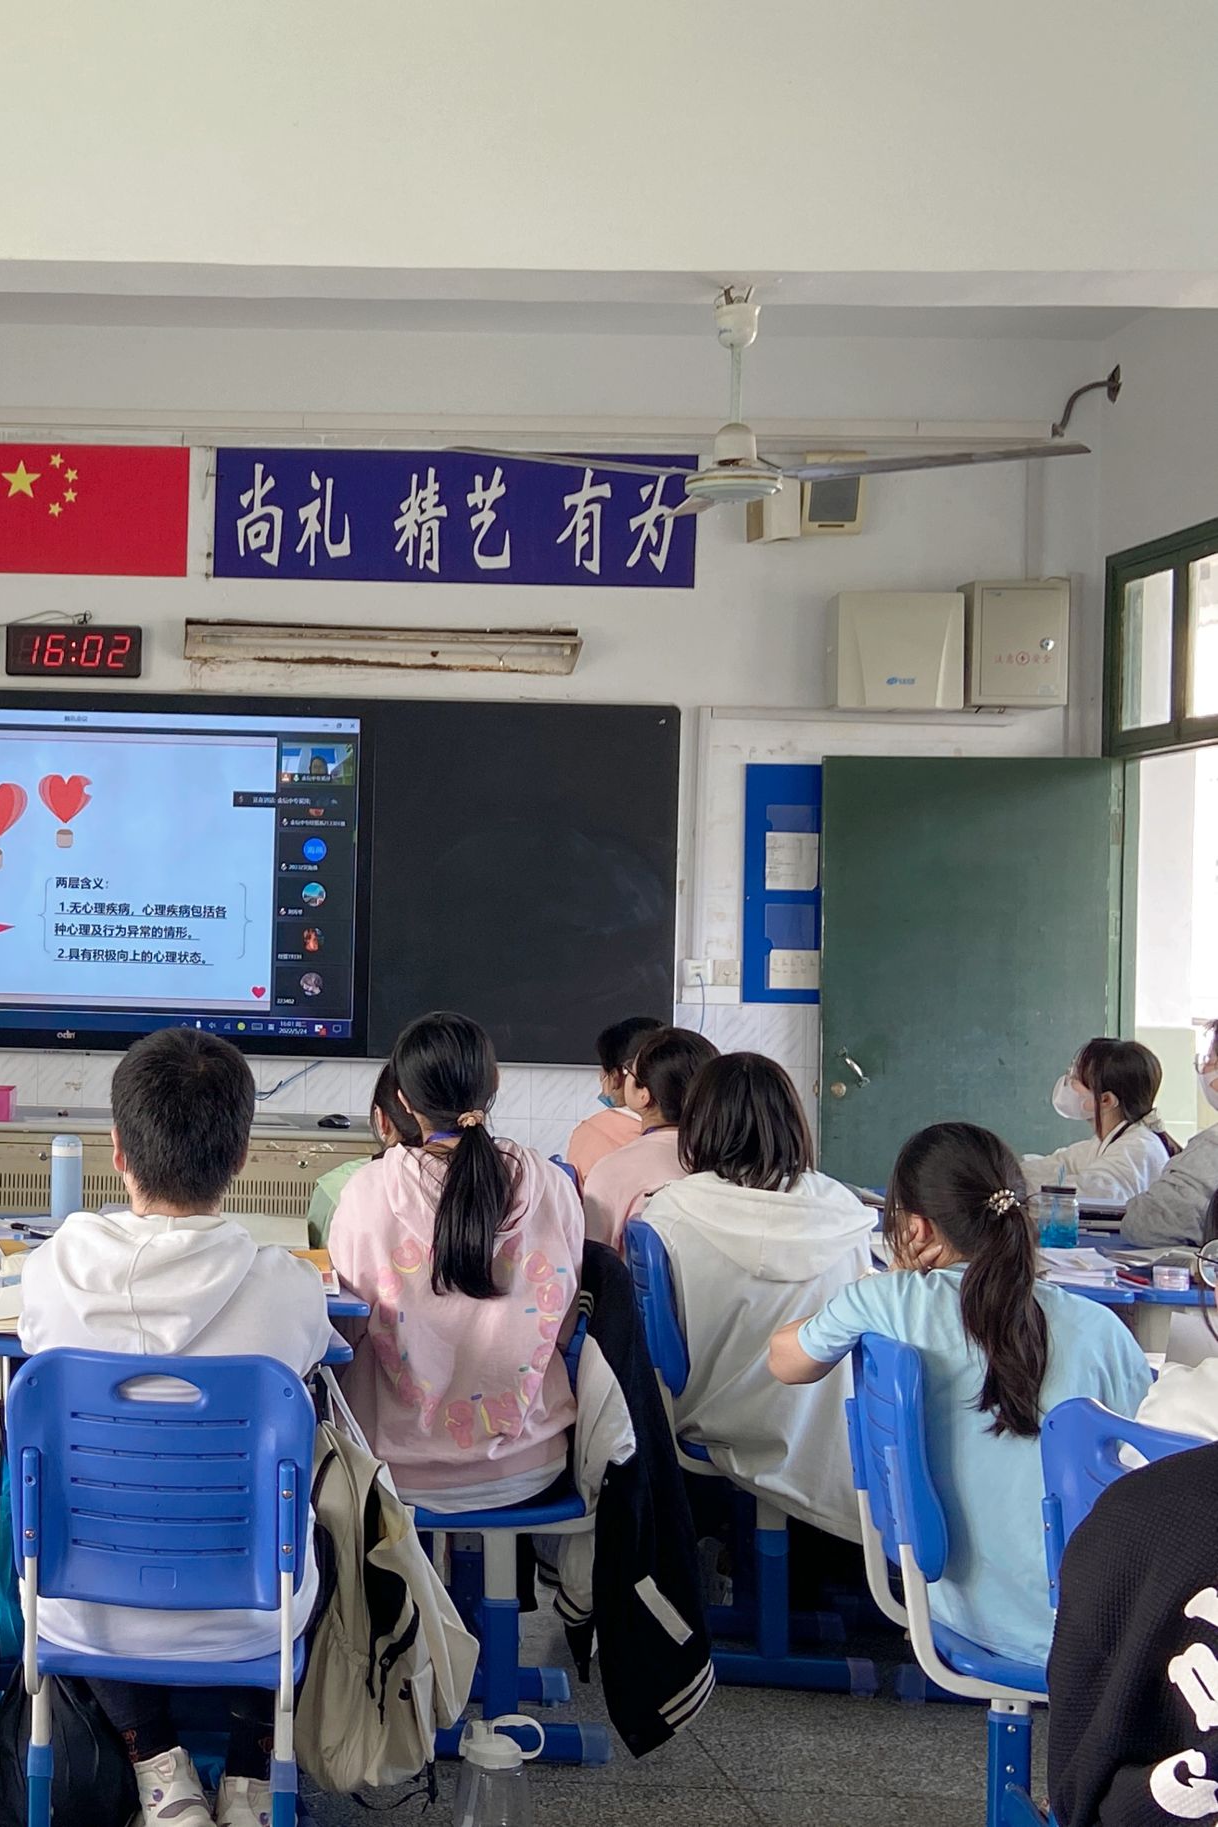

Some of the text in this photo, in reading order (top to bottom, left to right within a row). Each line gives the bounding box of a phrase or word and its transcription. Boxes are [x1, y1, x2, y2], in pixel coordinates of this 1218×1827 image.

[235, 463, 677, 575] 尚礼 精艺 有为
[30, 633, 131, 668] 16:02
[55, 877, 109, 890] 两层含义：
[54, 923, 193, 940] 种心理及行为异常的情形。
